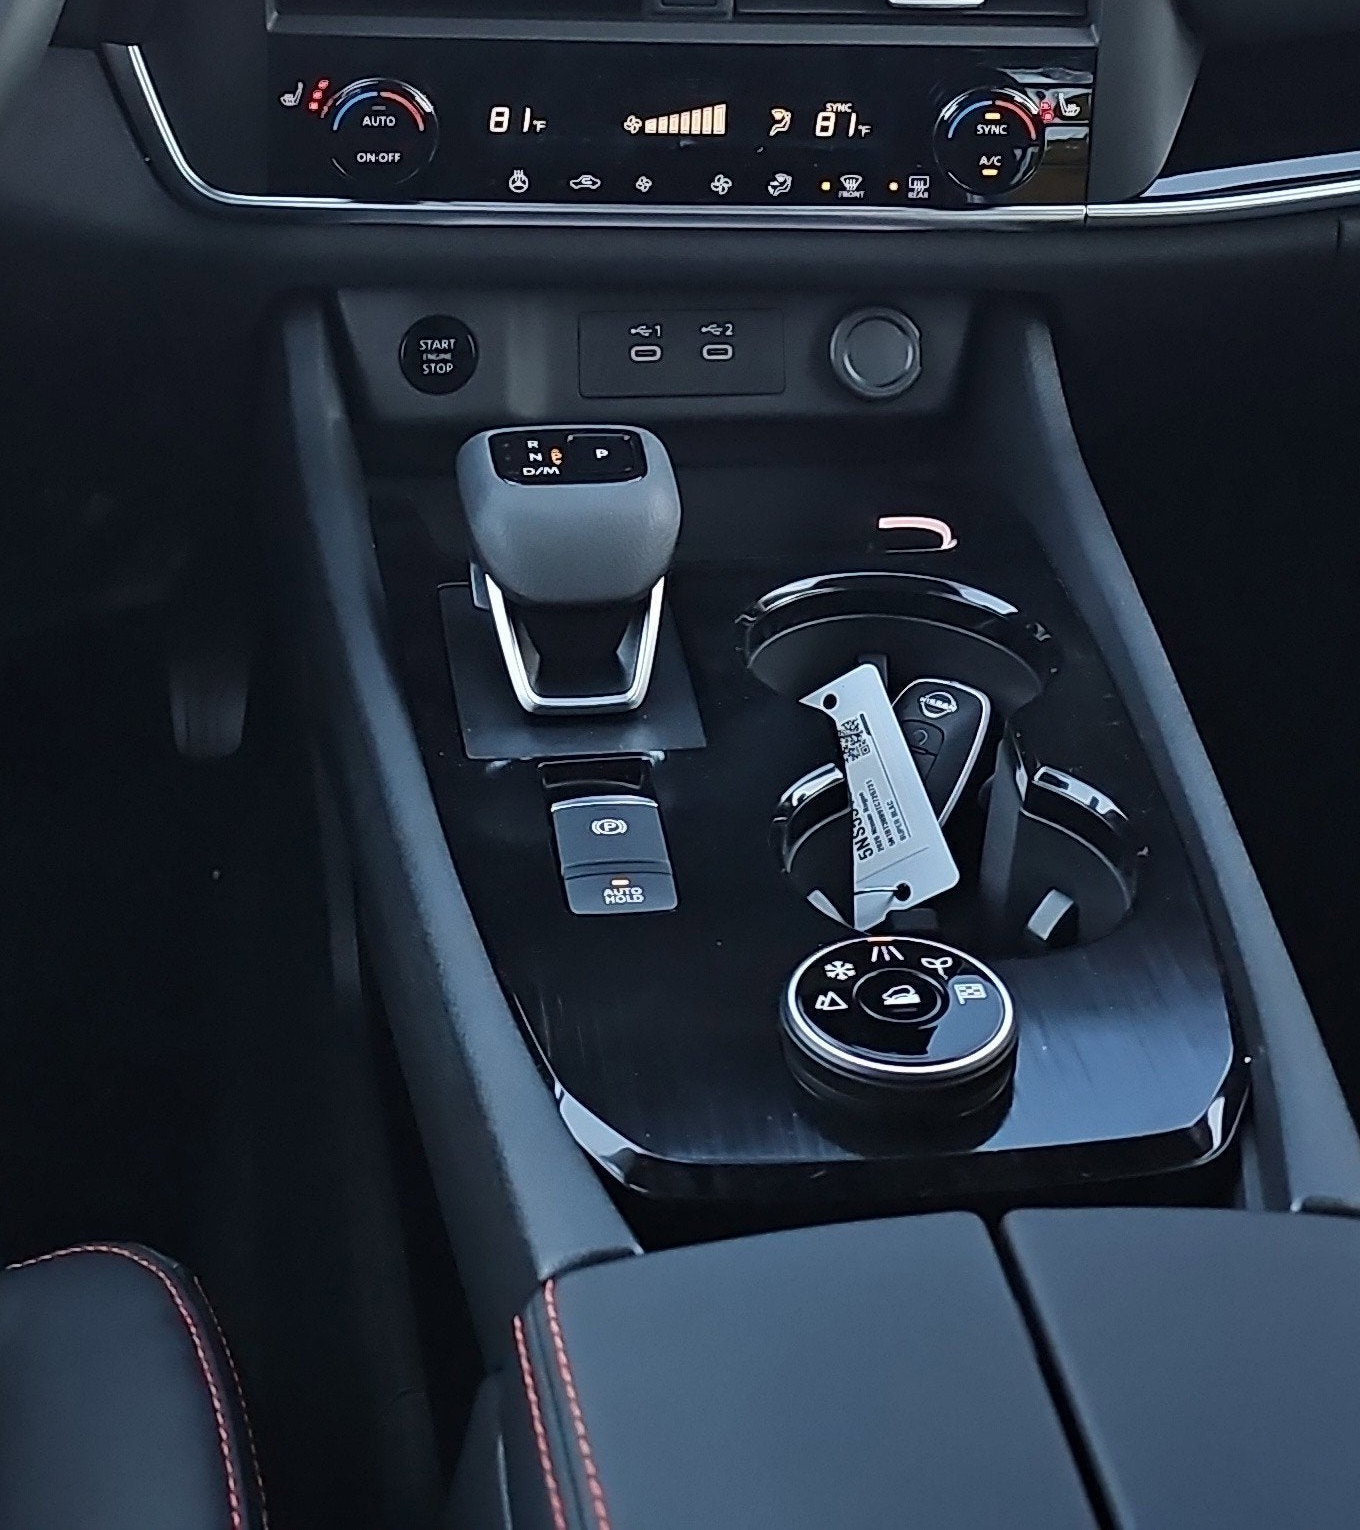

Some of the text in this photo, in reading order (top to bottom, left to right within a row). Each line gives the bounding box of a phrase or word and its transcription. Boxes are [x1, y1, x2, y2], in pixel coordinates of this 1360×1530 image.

[826, 102, 852, 112] SYNC
[362, 115, 396, 127] AUTO
[976, 124, 1008, 135] SYNC
[979, 155, 1001, 166] A/C
[654, 325, 661, 337] 1
[725, 323, 733, 336] 2
[420, 338, 456, 350] START
[423, 363, 453, 374] STOP
[527, 440, 539, 448] R
[529, 453, 542, 461] N
[596, 449, 608, 458] P
[523, 467, 560, 475] D/M
[603, 887, 642, 897] AUTO
[605, 895, 644, 904] HOLD
